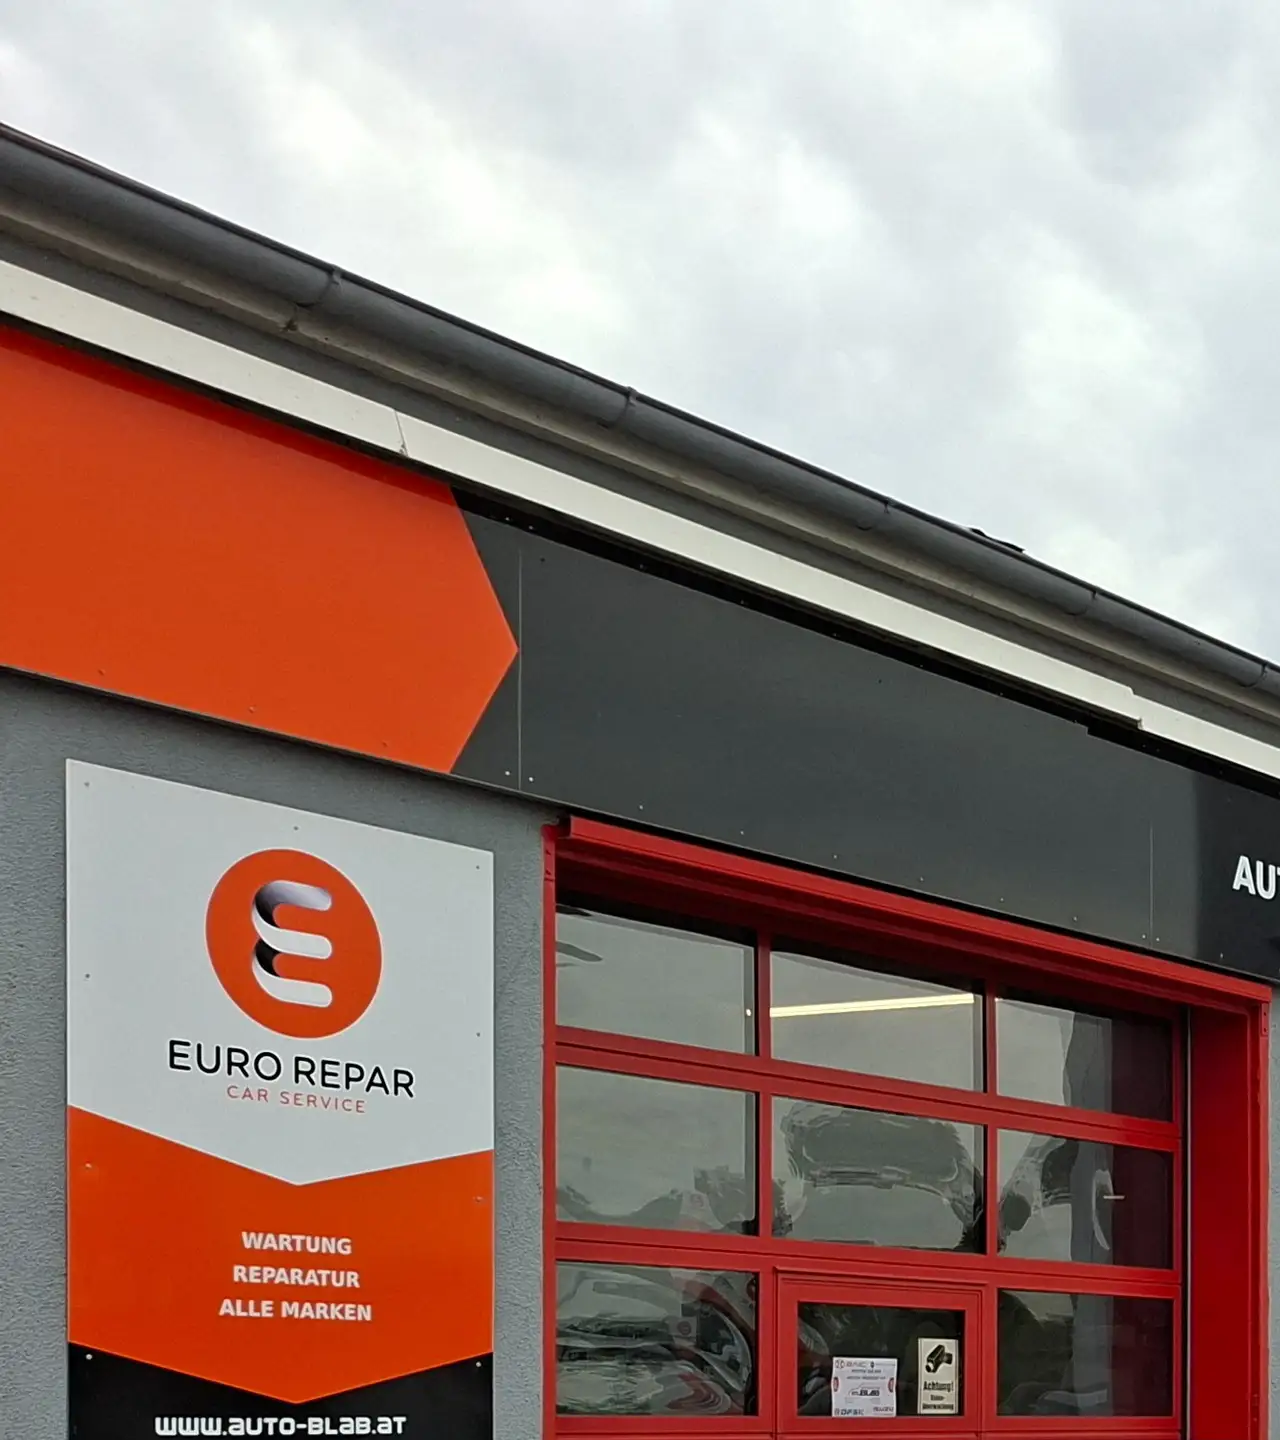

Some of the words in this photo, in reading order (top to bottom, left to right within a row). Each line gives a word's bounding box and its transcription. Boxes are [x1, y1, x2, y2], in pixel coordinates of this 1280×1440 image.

[168, 1039, 282, 1081] EURO
[293, 1055, 415, 1098] REPAR
[226, 1084, 269, 1103] CAR
[279, 1090, 366, 1114] SERVICE
[241, 1231, 352, 1255] WARTUNG
[233, 1265, 360, 1288] REPARATUR
[218, 1298, 274, 1317] ALLE
[281, 1301, 372, 1321] MARKEN
